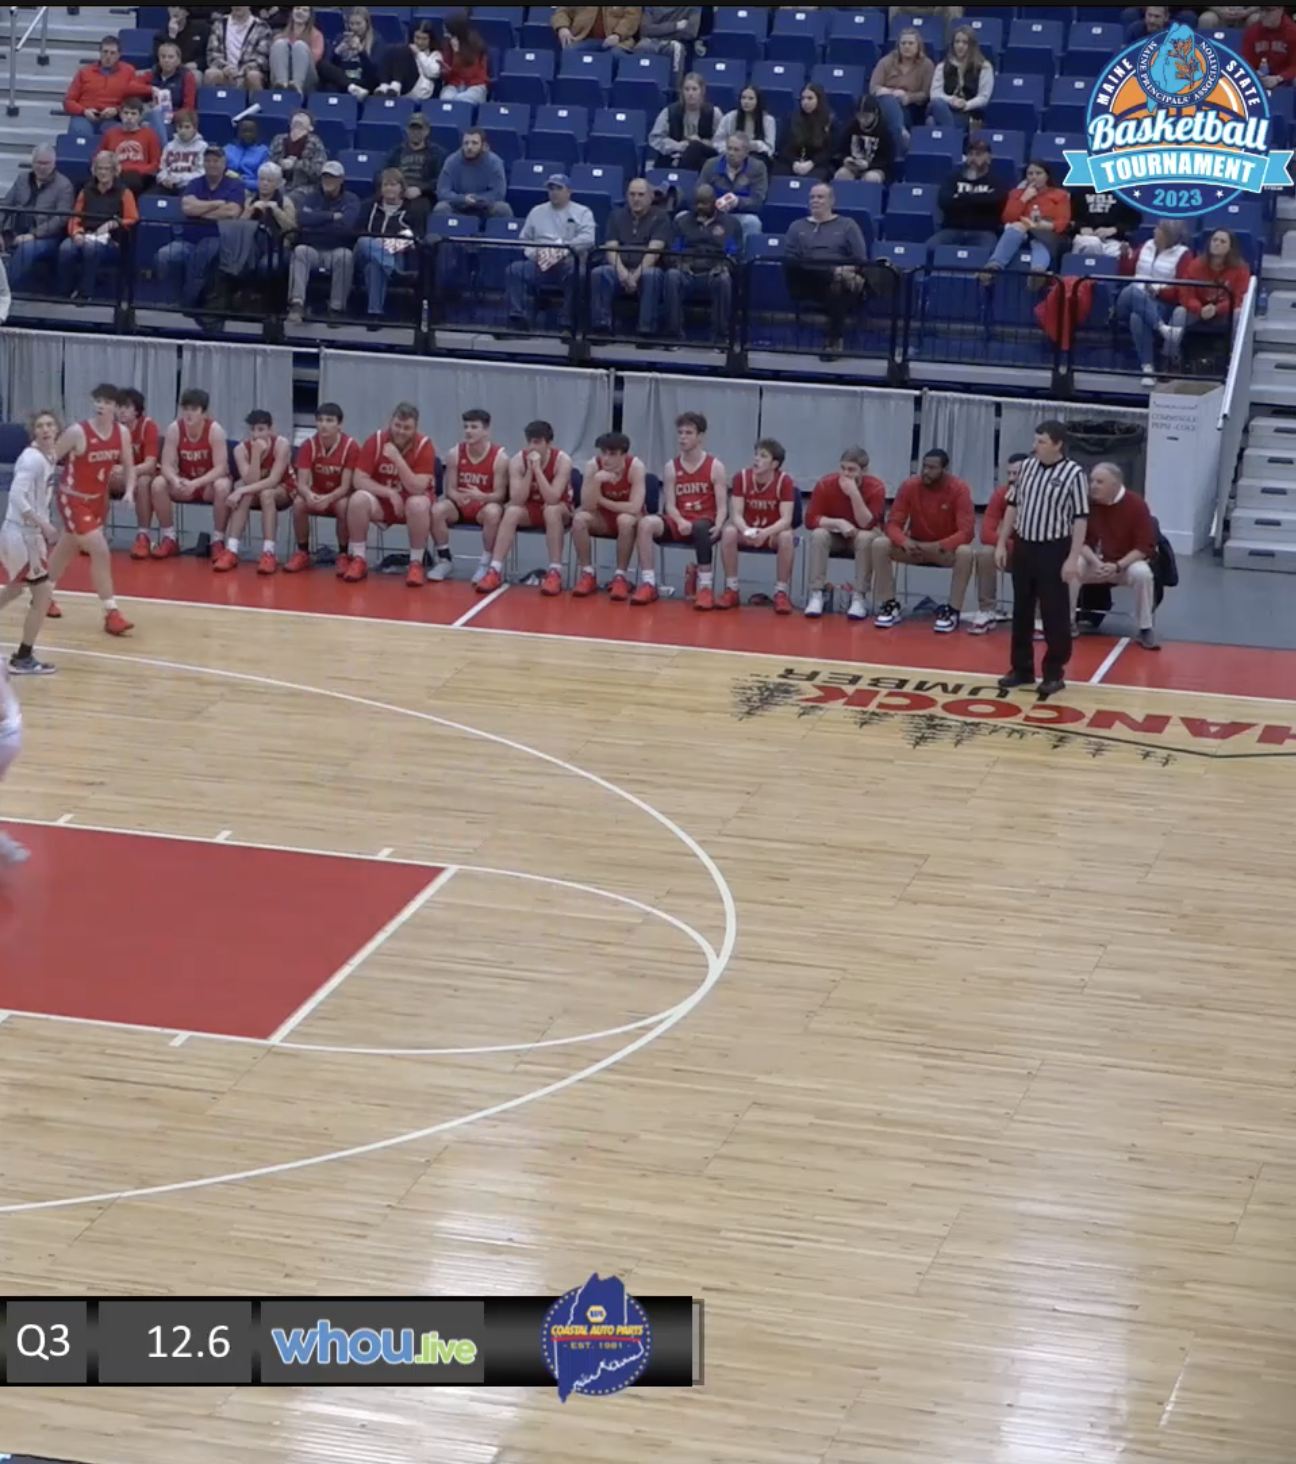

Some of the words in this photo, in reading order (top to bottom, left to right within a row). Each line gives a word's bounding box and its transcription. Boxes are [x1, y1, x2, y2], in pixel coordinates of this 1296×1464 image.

[88, 449, 121, 463] CONY
[180, 449, 208, 461] CONY
[459, 471, 488, 485] CONY
[675, 482, 708, 495] CONY
